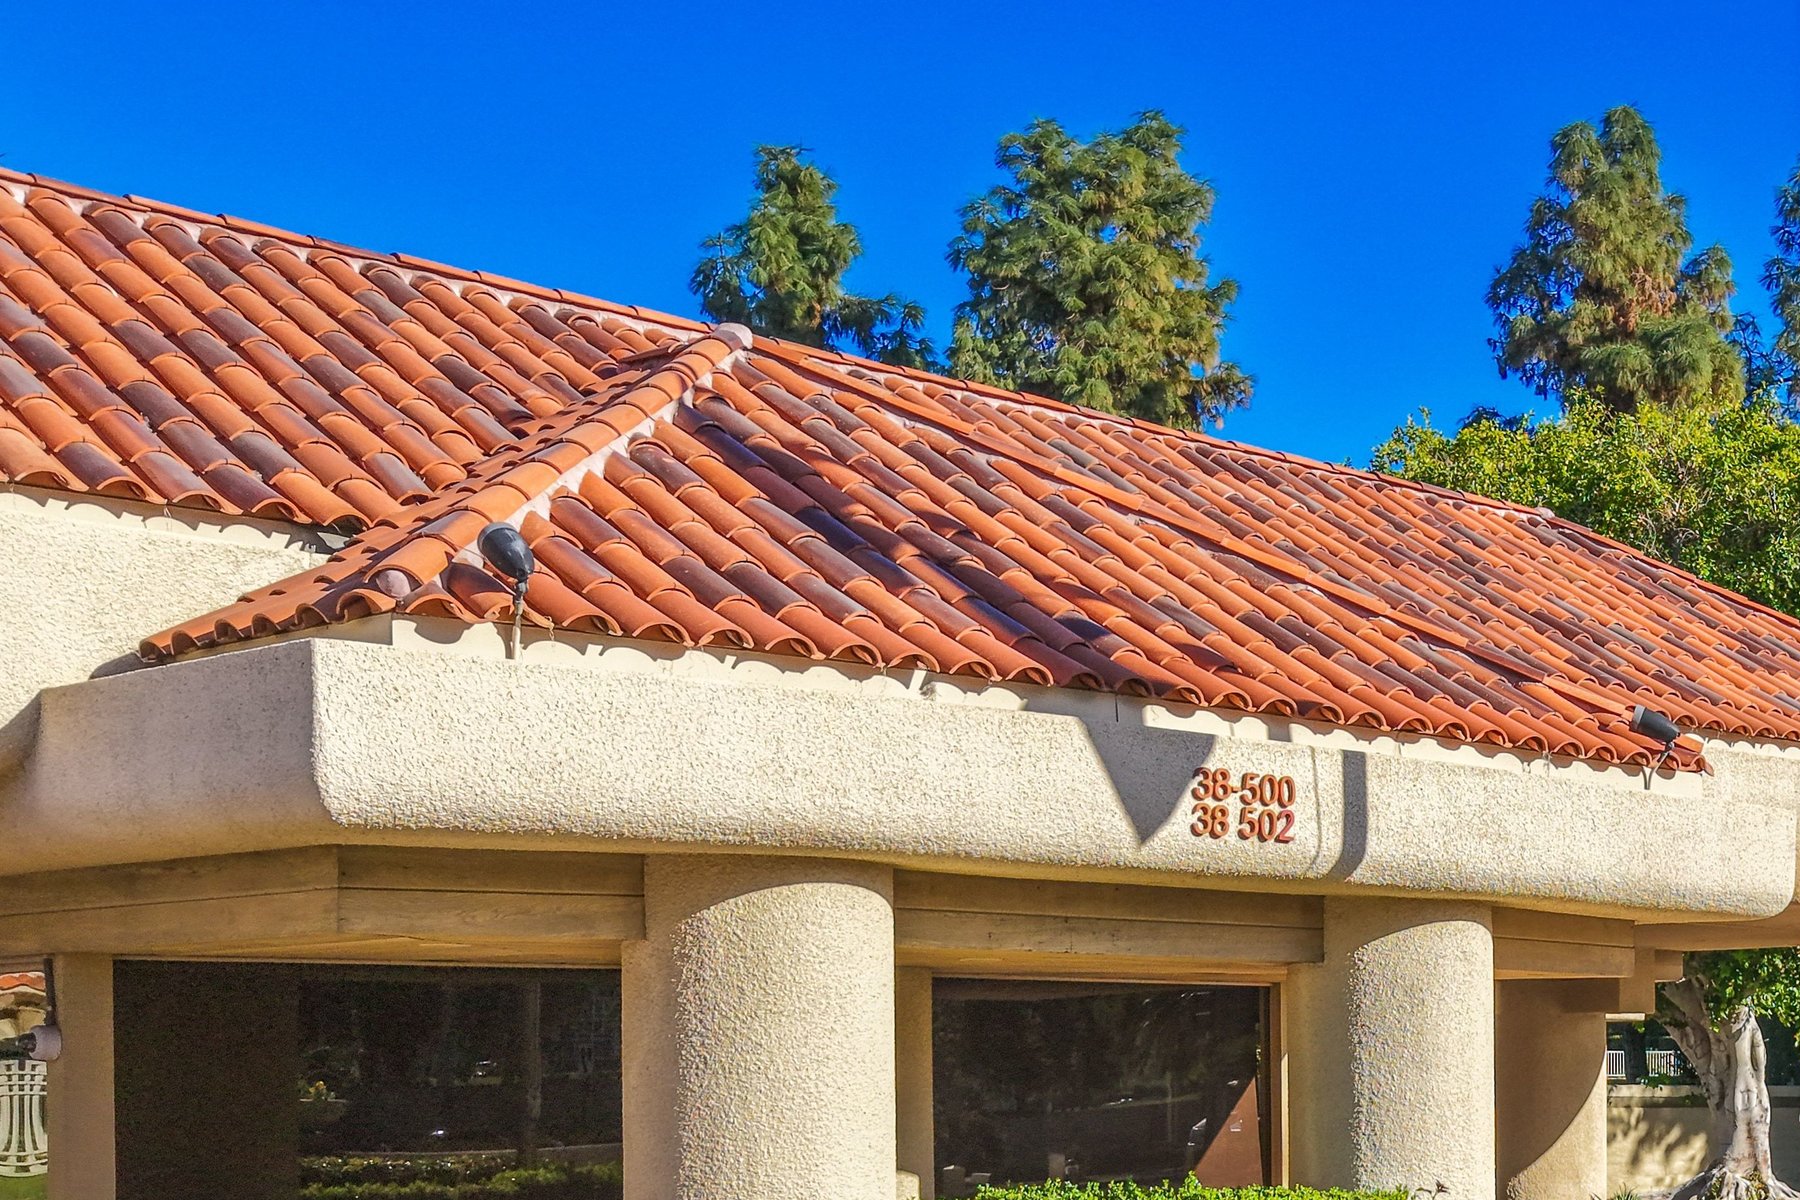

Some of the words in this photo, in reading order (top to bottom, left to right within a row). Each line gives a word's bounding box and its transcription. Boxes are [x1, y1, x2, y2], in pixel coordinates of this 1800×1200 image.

[1191, 767, 1296, 808] 38-500
[1190, 802, 1229, 839] 38
[1237, 806, 1295, 844] 502
